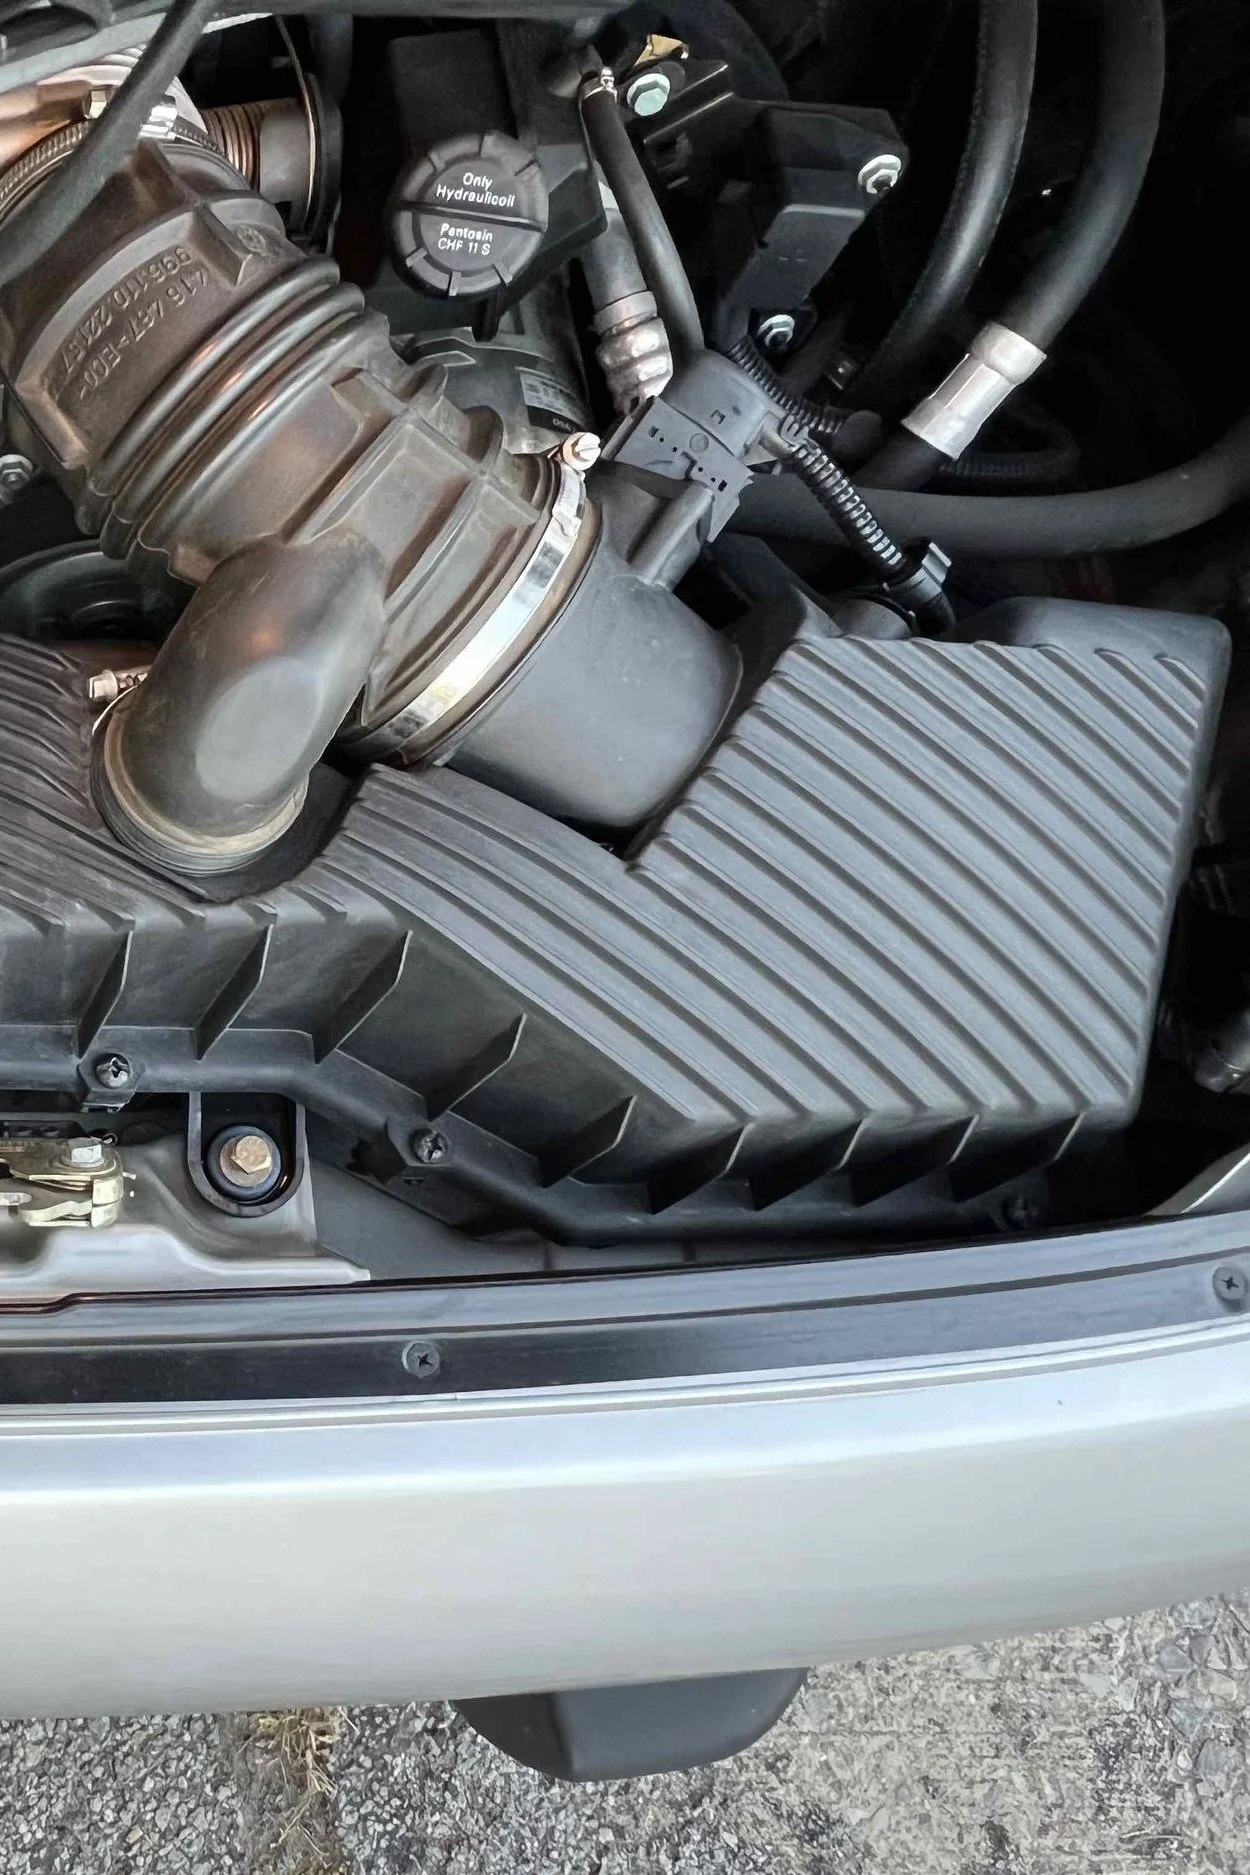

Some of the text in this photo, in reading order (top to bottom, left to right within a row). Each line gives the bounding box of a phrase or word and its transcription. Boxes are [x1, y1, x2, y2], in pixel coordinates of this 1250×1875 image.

[462, 172, 493, 190] Only
[436, 184, 515, 207] Hydraulicoil
[440, 223, 493, 242] Pentosin
[438, 237, 491, 255] CHF 11 S
